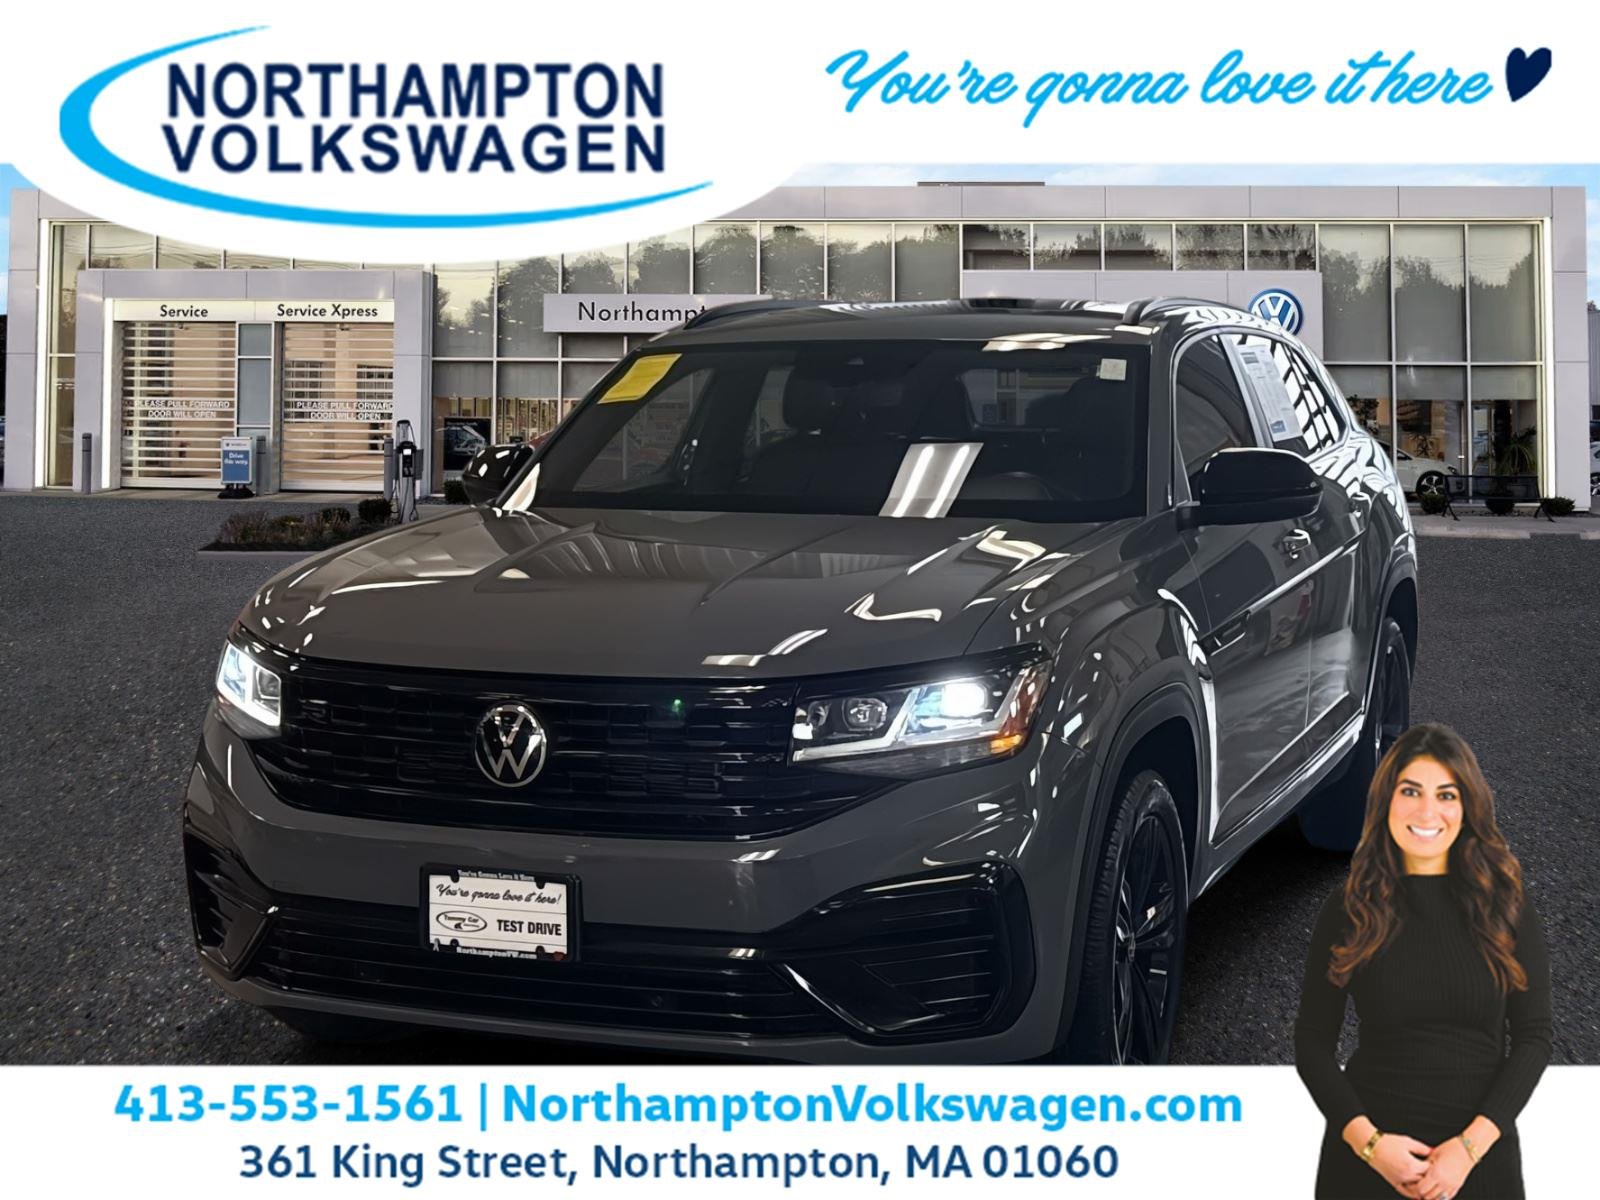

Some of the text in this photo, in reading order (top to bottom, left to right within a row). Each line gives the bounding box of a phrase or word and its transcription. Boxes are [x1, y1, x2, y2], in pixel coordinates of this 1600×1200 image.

[159, 304, 209, 318] Service
[277, 303, 378, 319] Service Xpress
[496, 919, 562, 936] TEST DRIVE
